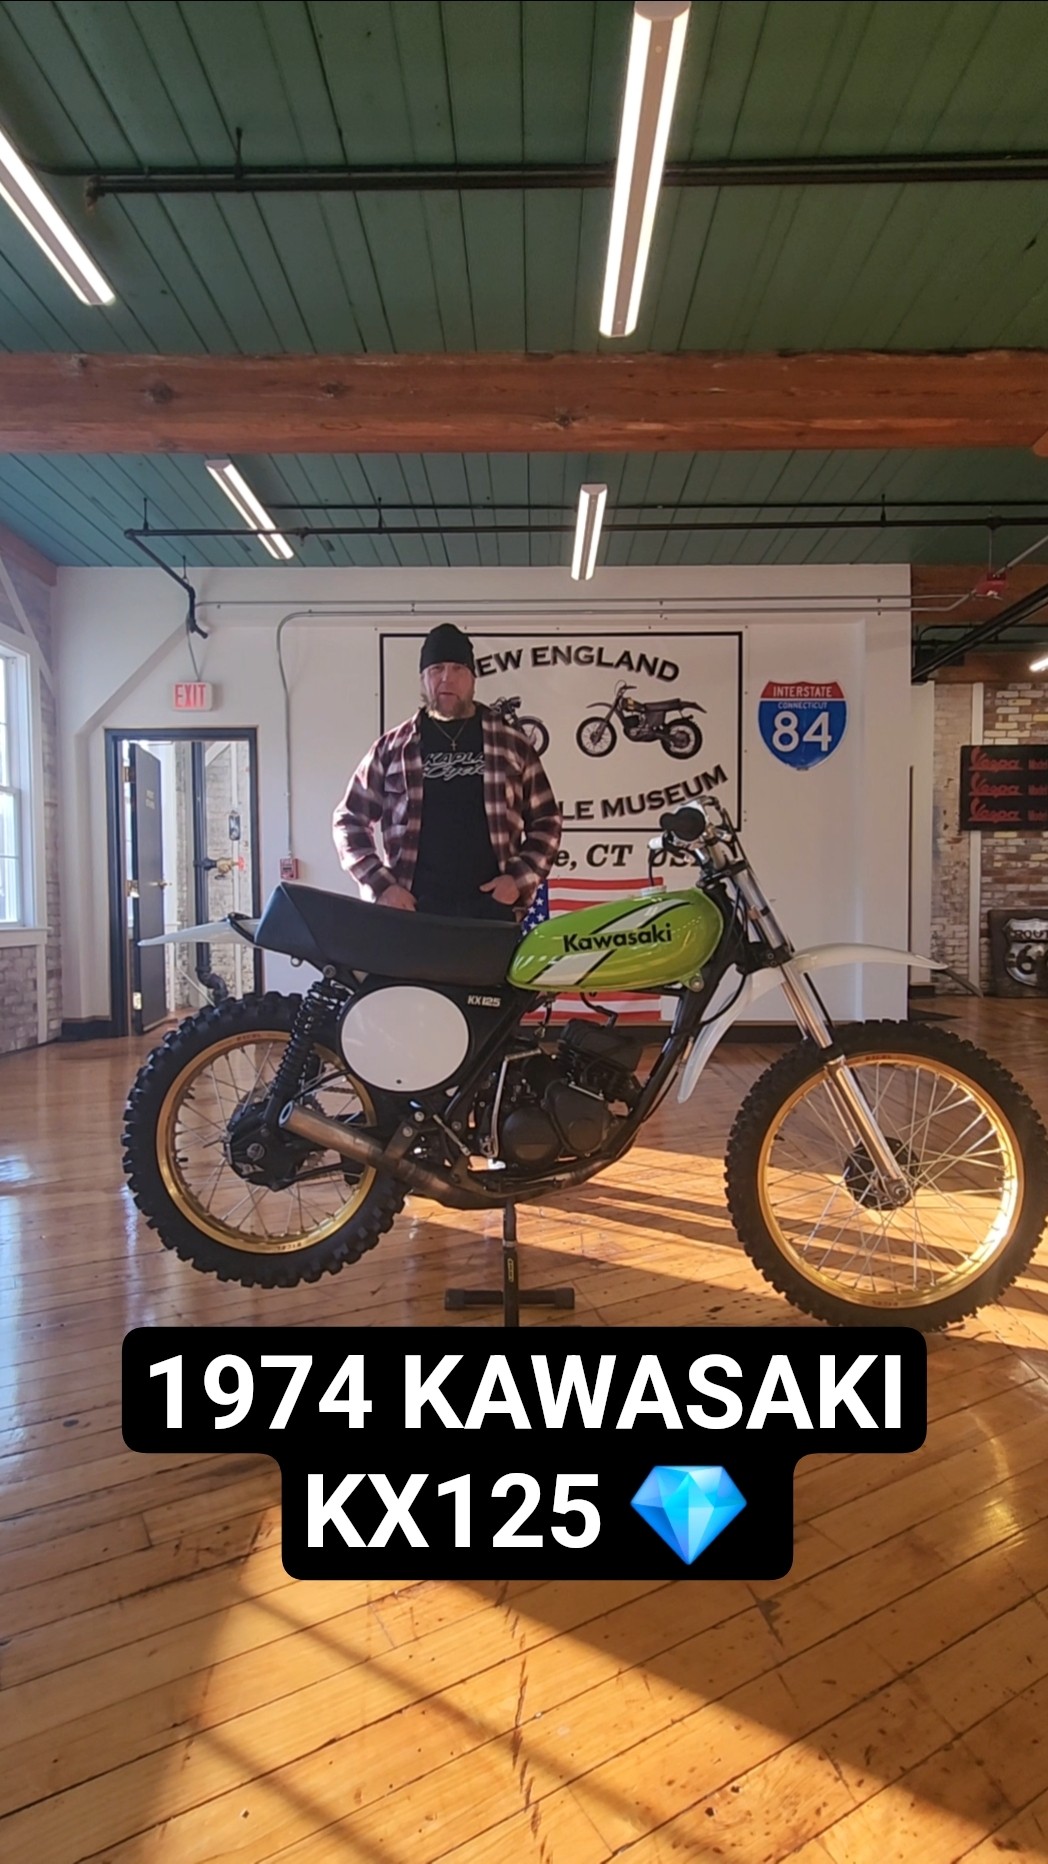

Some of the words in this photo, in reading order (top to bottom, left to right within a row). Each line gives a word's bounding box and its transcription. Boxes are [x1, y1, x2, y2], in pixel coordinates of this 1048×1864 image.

[474, 649, 523, 678] EW
[531, 645, 680, 682] ENGLAND
[174, 684, 207, 708] EXIT
[773, 686, 832, 697] INTERSTATE
[772, 710, 832, 752] 84
[422, 752, 485, 766] KAPLA
[559, 800, 594, 820] LE
[602, 764, 728, 819] MUSEUM
[586, 844, 633, 867] CT
[563, 923, 672, 952] Kawasaki
